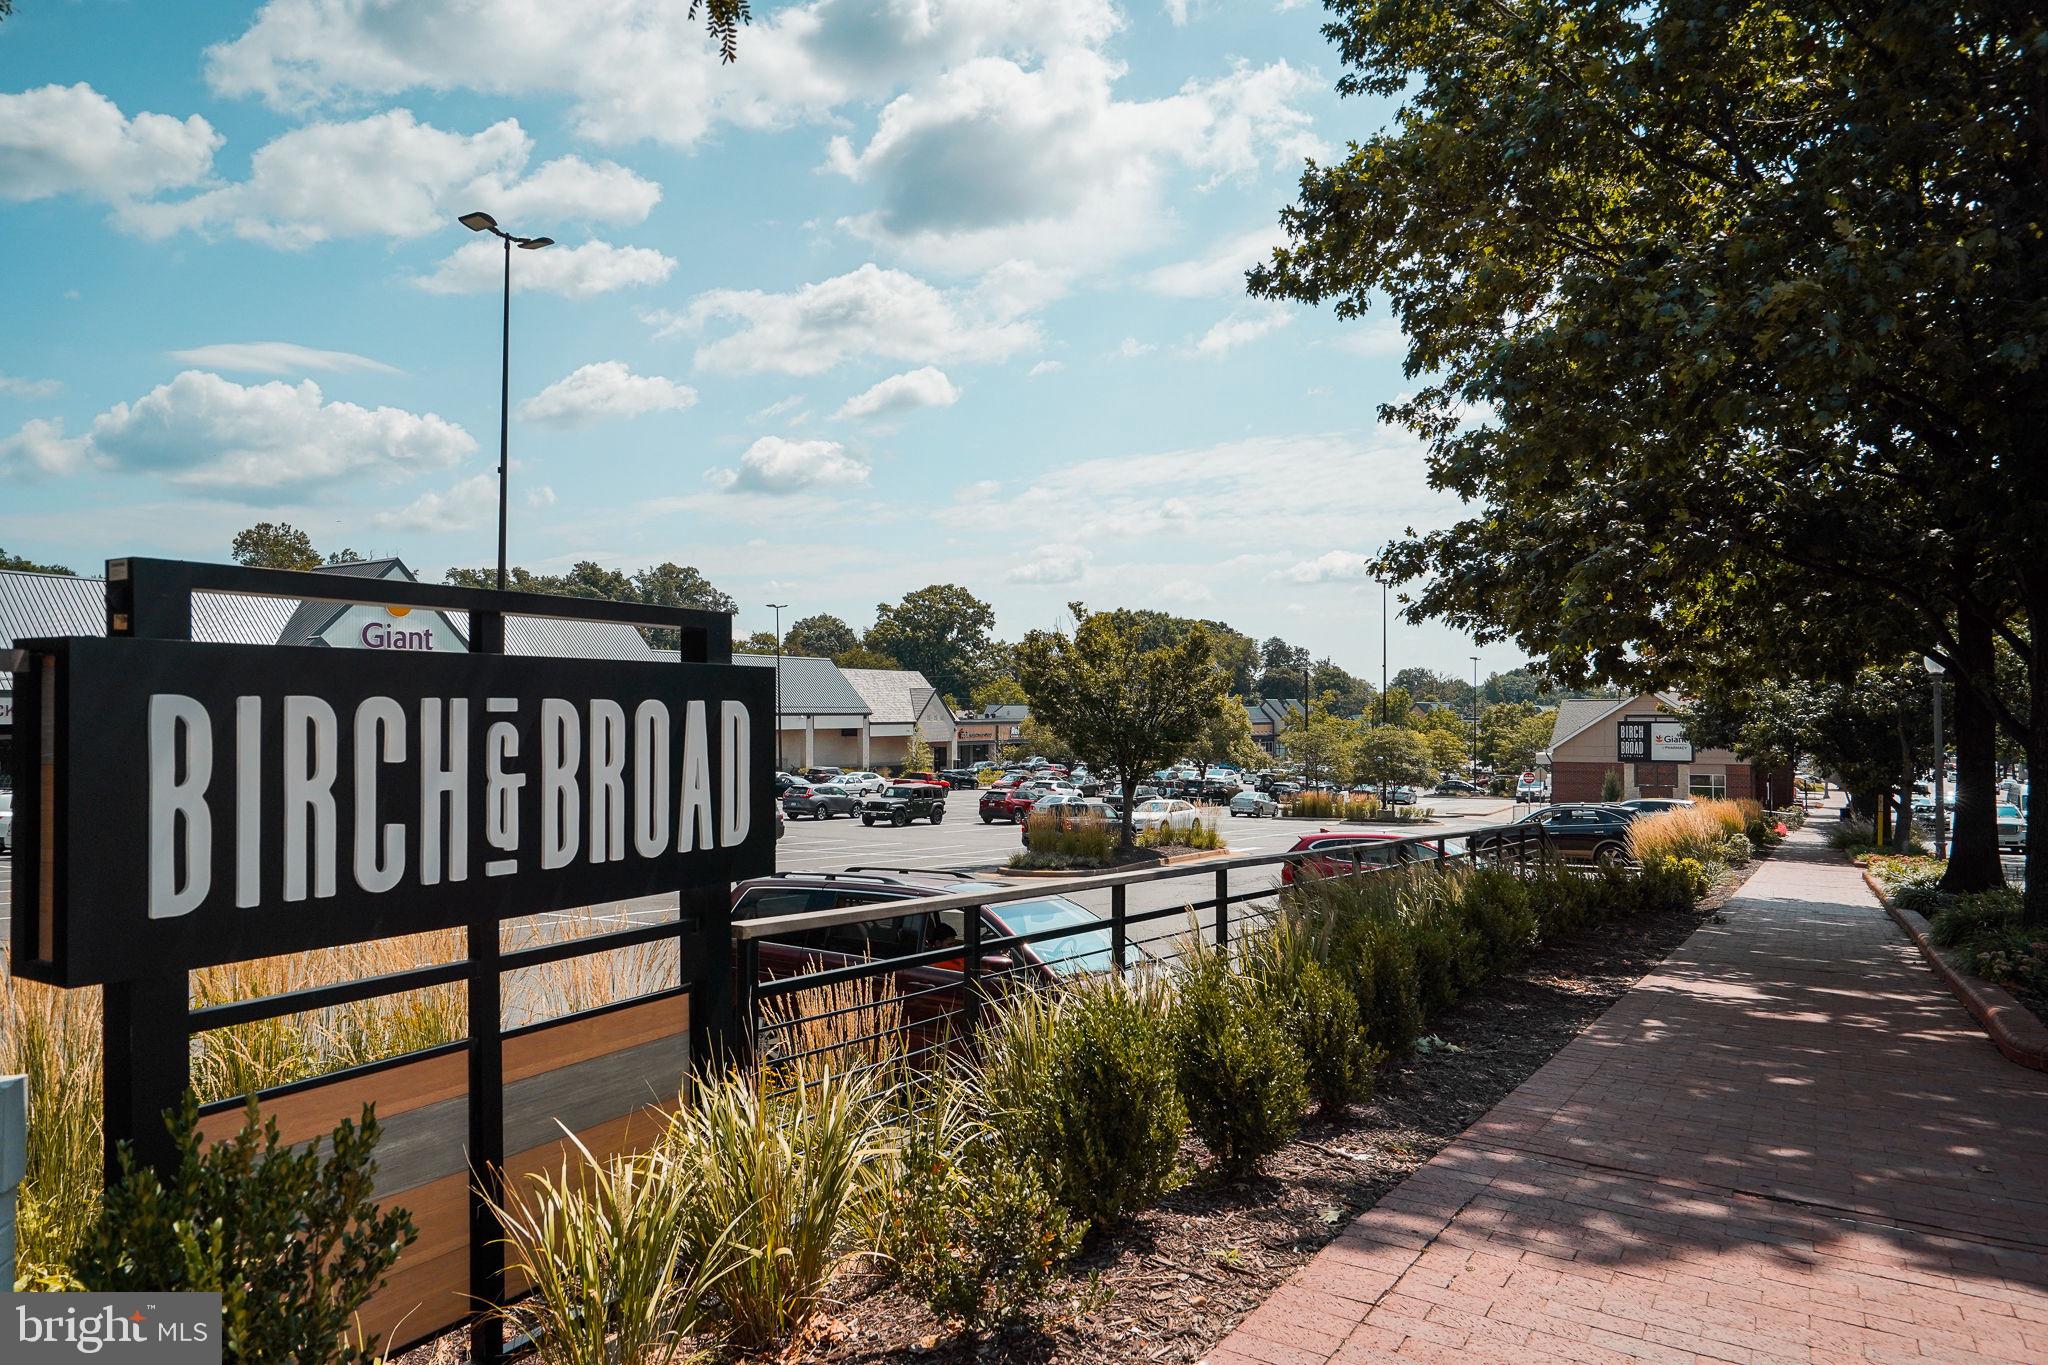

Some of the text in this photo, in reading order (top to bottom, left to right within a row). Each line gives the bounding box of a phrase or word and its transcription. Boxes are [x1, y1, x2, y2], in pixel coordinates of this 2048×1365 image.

[361, 622, 433, 650] Giant
[1620, 725, 1644, 739] BIRCH
[1664, 735, 1688, 743] Gian
[1620, 742, 1644, 754] BROAD
[148, 694, 751, 919] BIRCH & BROAD
